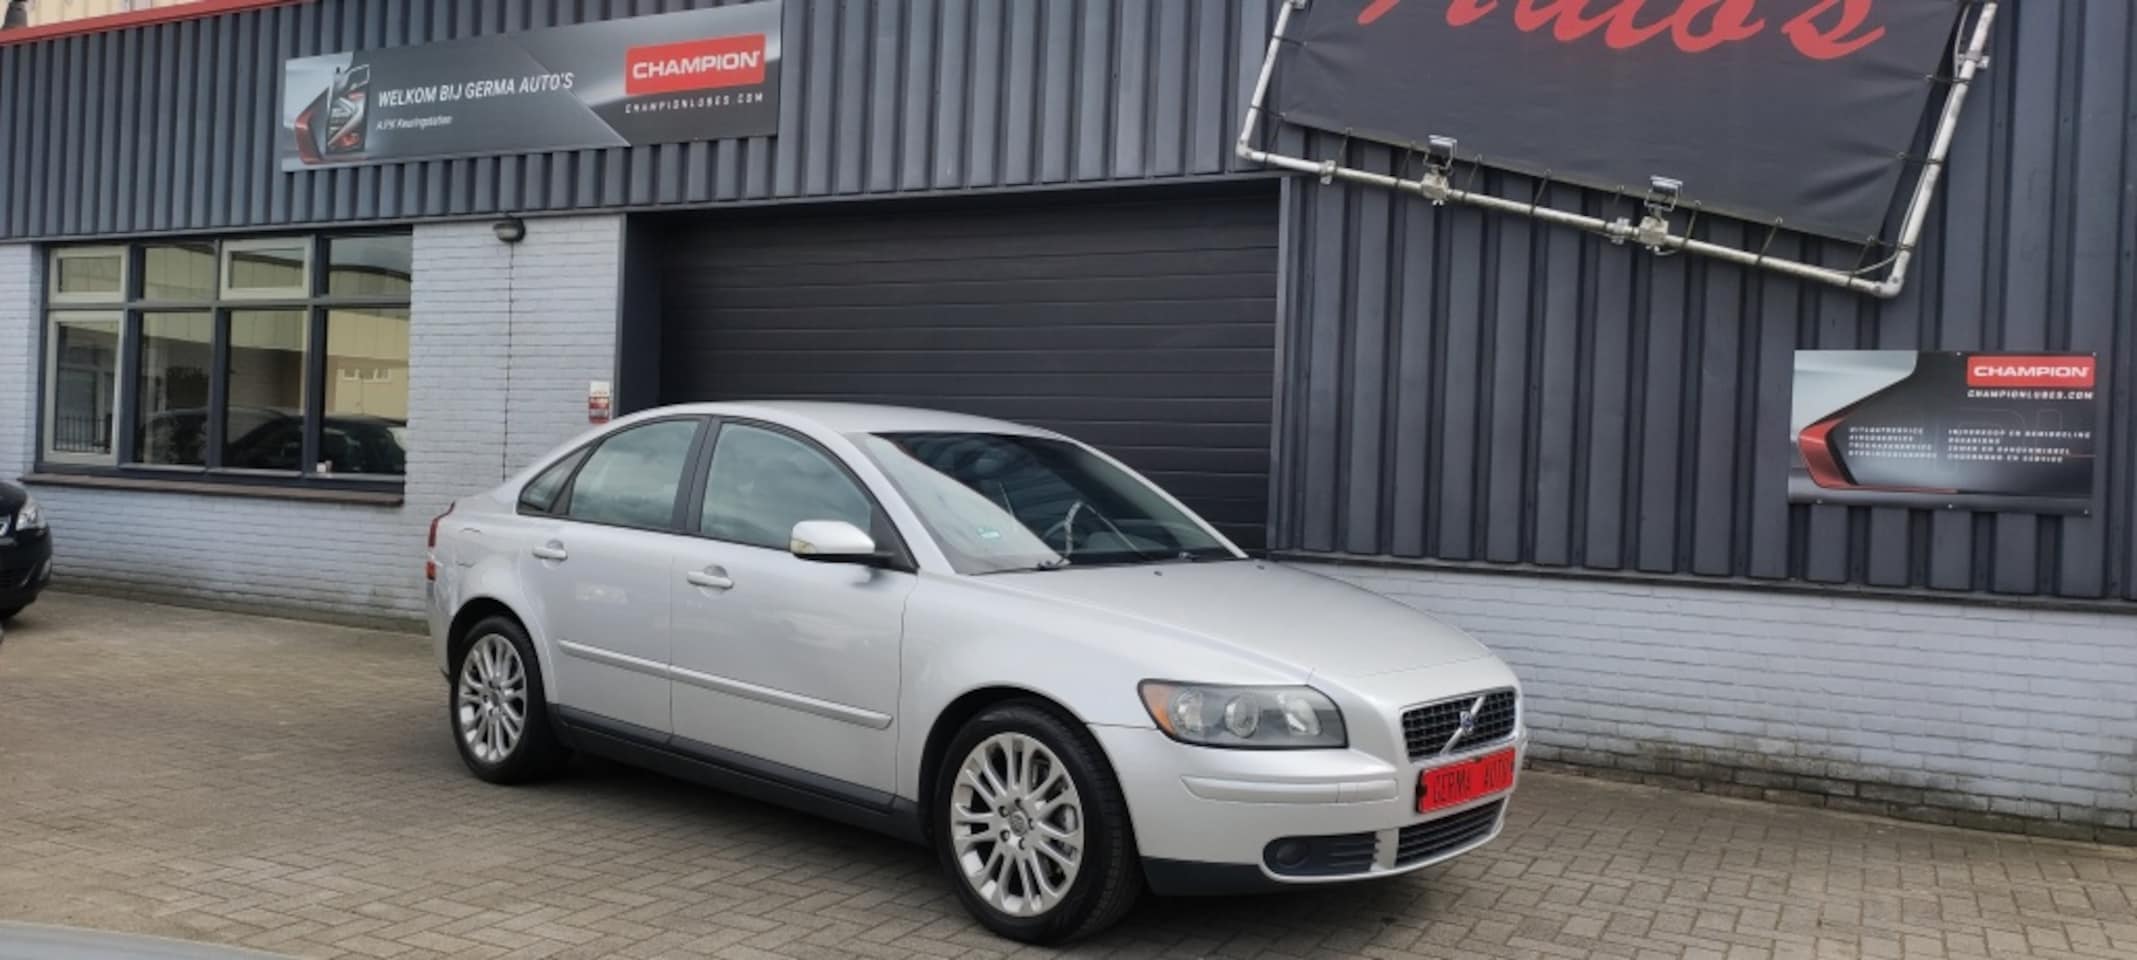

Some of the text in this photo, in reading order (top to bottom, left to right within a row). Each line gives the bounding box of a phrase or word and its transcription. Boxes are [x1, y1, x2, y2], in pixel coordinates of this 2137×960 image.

[632, 51, 760, 79] CHAMPION
[379, 72, 575, 107] WELKOM BIJ GERMA AUTO'S
[1973, 366, 2090, 378] CHAMPION
[1967, 389, 2094, 400] CHAMPIONLUBES.COM
